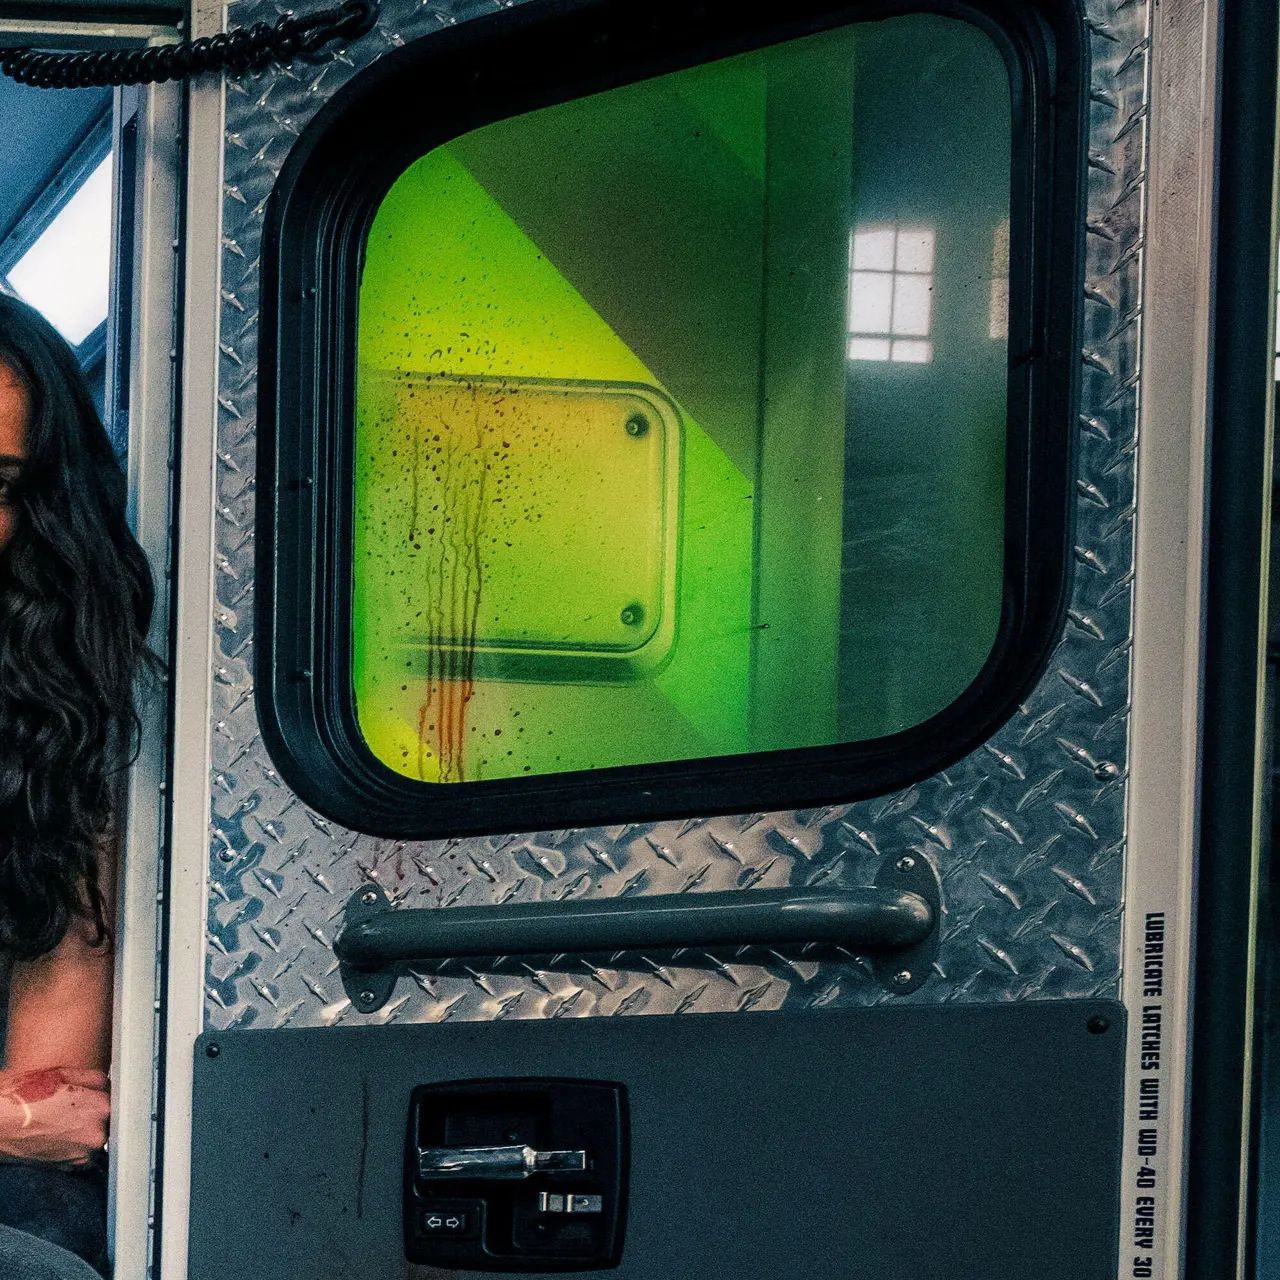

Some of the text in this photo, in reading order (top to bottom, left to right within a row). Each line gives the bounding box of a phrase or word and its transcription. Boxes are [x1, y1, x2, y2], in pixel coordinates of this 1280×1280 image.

[1143, 912, 1164, 997] LUBRICATE
[1141, 1005, 1162, 1070] LATCHES
[1139, 1078, 1159, 1121] WITH
[1136, 1129, 1157, 1189] WD-40
[1134, 1196, 1155, 1249] EVERY
[1132, 1256, 1152, 1278] 30
